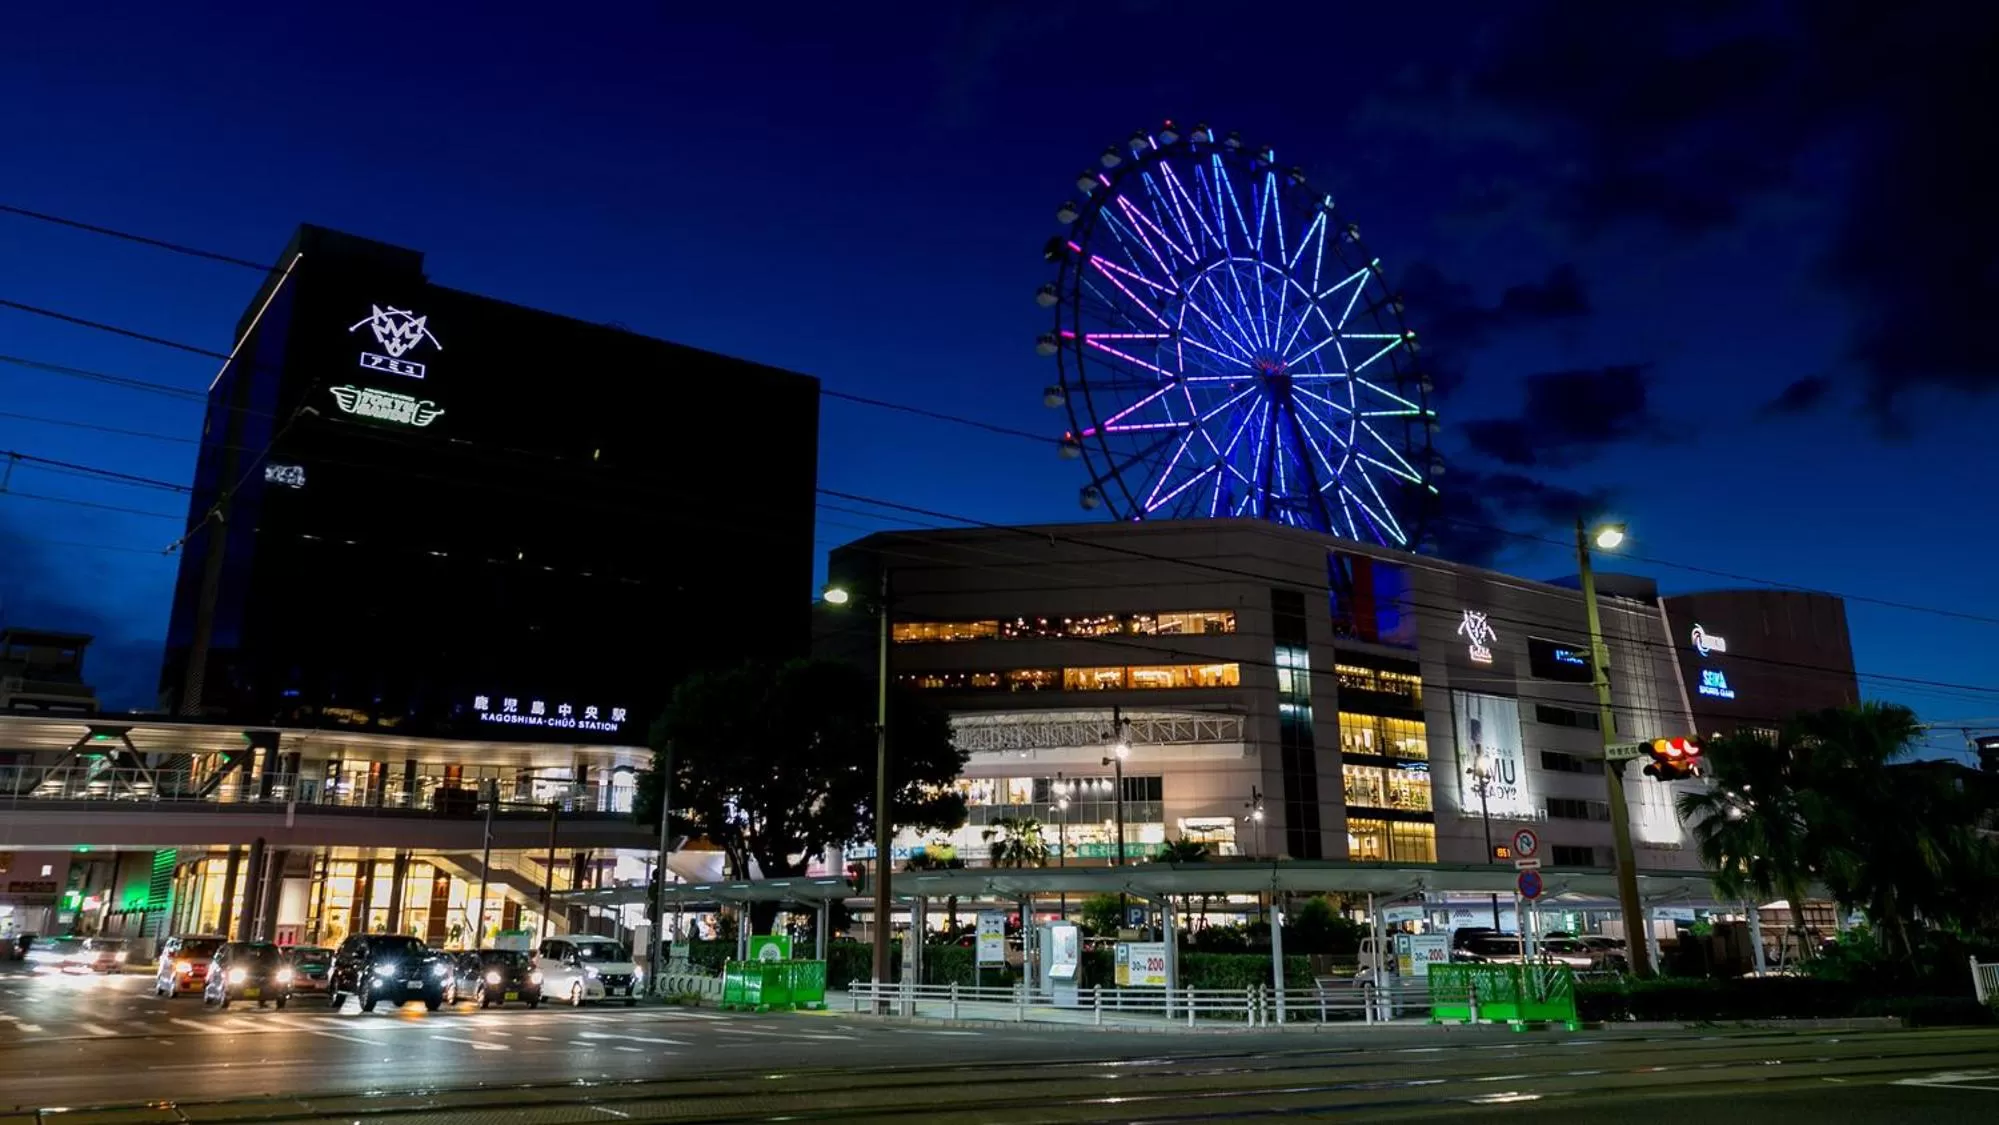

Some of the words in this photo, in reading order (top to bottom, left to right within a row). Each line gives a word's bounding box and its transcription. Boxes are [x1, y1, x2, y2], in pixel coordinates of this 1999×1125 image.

[371, 356, 415, 374] アミュ
[473, 695, 627, 723] 鹿児島中央駅
[578, 721, 618, 732] STATION
[1131, 908, 1142, 923] P
[1118, 945, 1127, 961] P
[1399, 937, 1409, 953] P
[1147, 958, 1164, 972] 200
